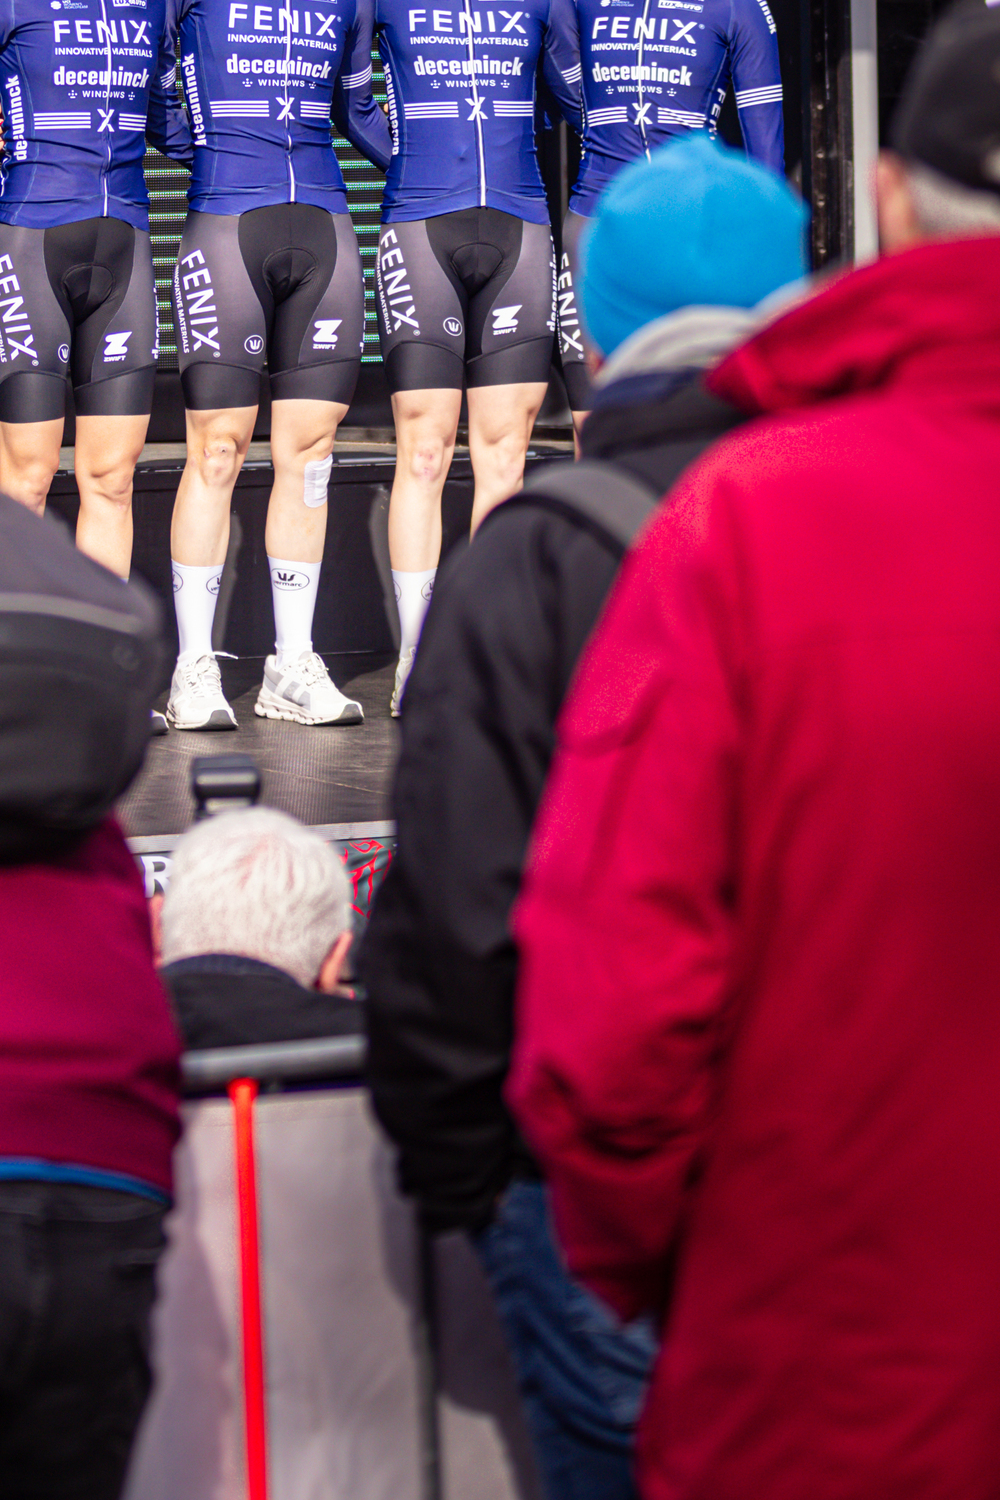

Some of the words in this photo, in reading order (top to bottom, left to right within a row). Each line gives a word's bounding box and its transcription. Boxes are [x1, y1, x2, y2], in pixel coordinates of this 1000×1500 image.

[53, 19, 151, 45] FENIX
[228, 3, 337, 39] FENIX
[408, 9, 527, 34] FENIX
[591, 16, 699, 44] FENIX
[54, 47, 109, 56] INNOVATIVE
[112, 47, 153, 58] MATERIALS
[227, 33, 288, 44] INNOVATIVE
[292, 37, 337, 52] MATERIALS
[410, 36, 470, 45] INNOVATIVE
[473, 37, 529, 47] MATERIALS
[643, 43, 698, 57] MATERIALS
[53, 65, 150, 88] deceuninck
[226, 53, 332, 79] deceuninck
[413, 54, 524, 76] deceuninck
[592, 62, 693, 87] deceuninck
[5, 74, 28, 161] deuninck
[379, 228, 420, 332] FENIX
[181, 249, 220, 351] FENIX
[379, 290, 393, 335] MATERIALS
[557, 252, 584, 354] FENIX
[178, 308, 190, 354] MATERIALS
[492, 327, 518, 336] ZWIFT
[103, 355, 127, 363] ZWIFT
